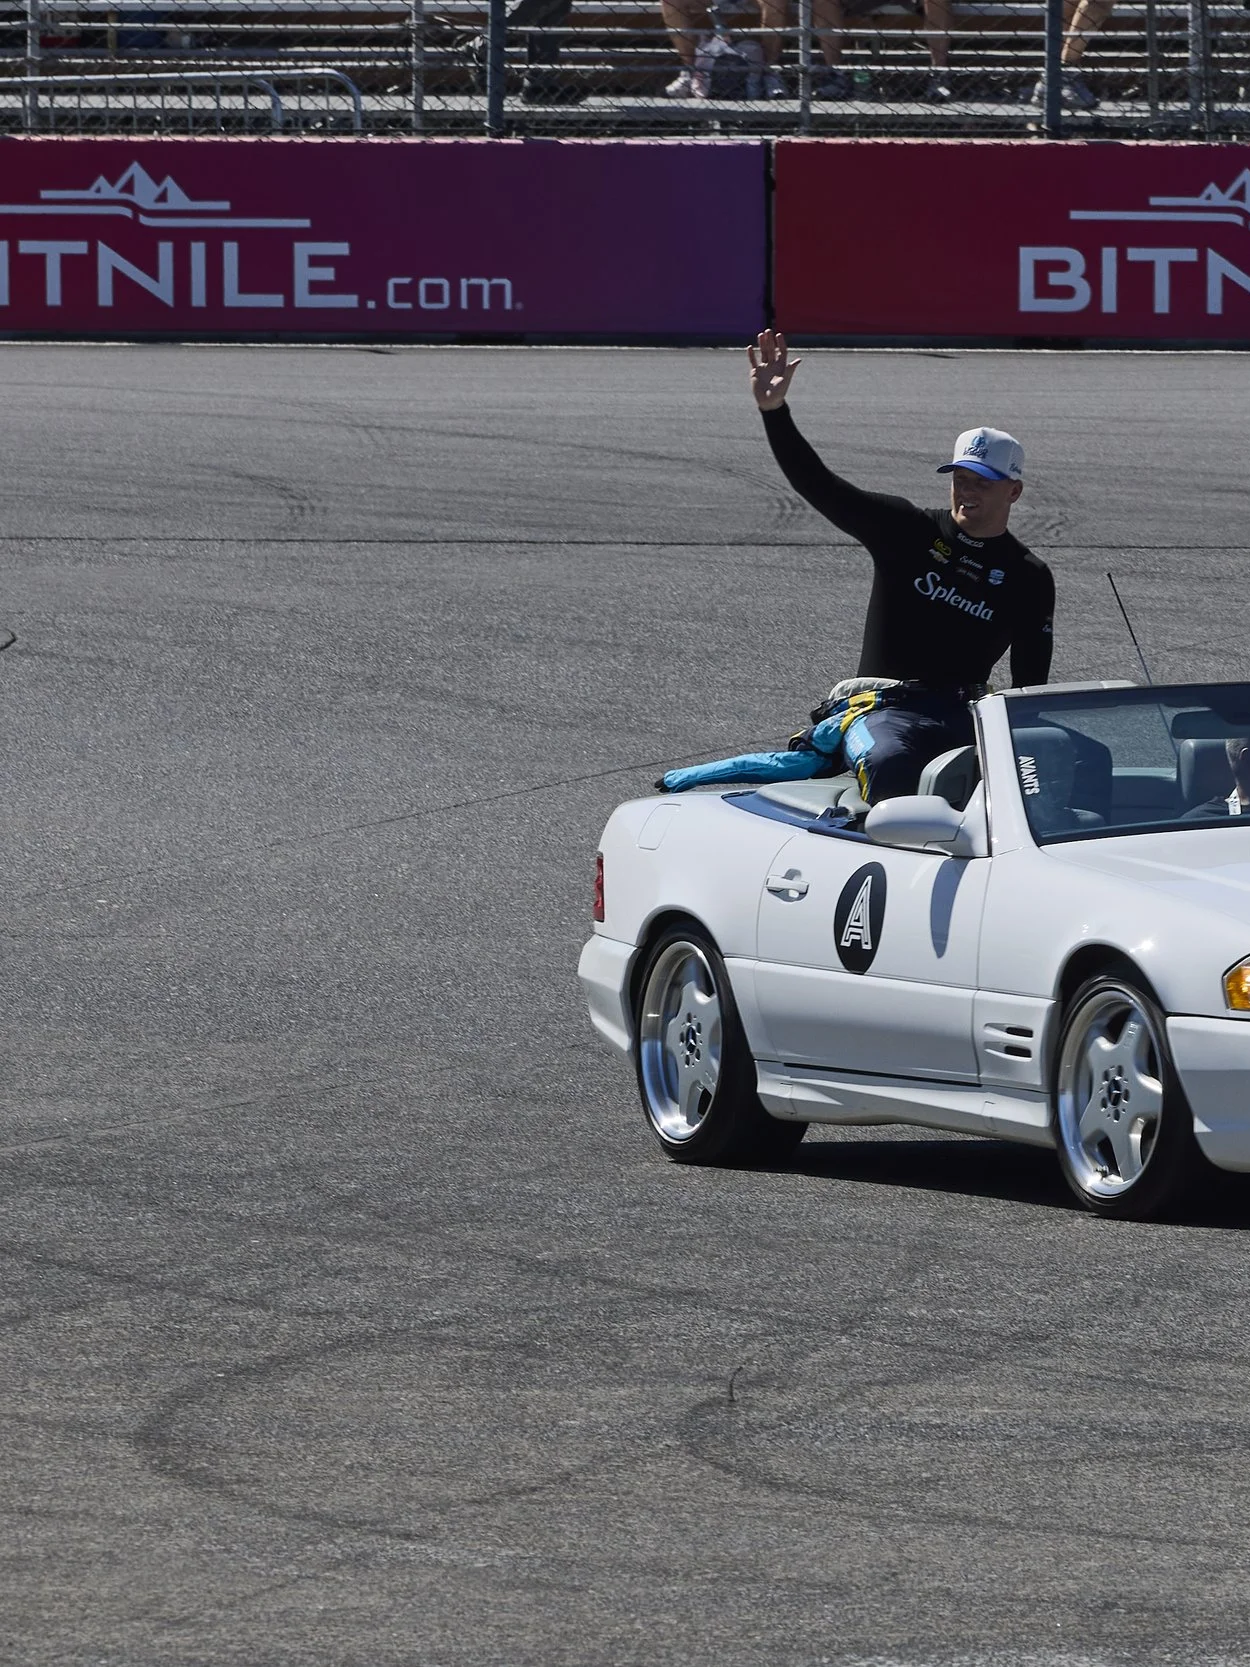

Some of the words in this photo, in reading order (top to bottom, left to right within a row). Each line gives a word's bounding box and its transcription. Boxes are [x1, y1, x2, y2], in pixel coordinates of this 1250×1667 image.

[913, 571, 994, 621] Splenda
[1018, 755, 1040, 795] AVANTS
[840, 875, 873, 950] A
